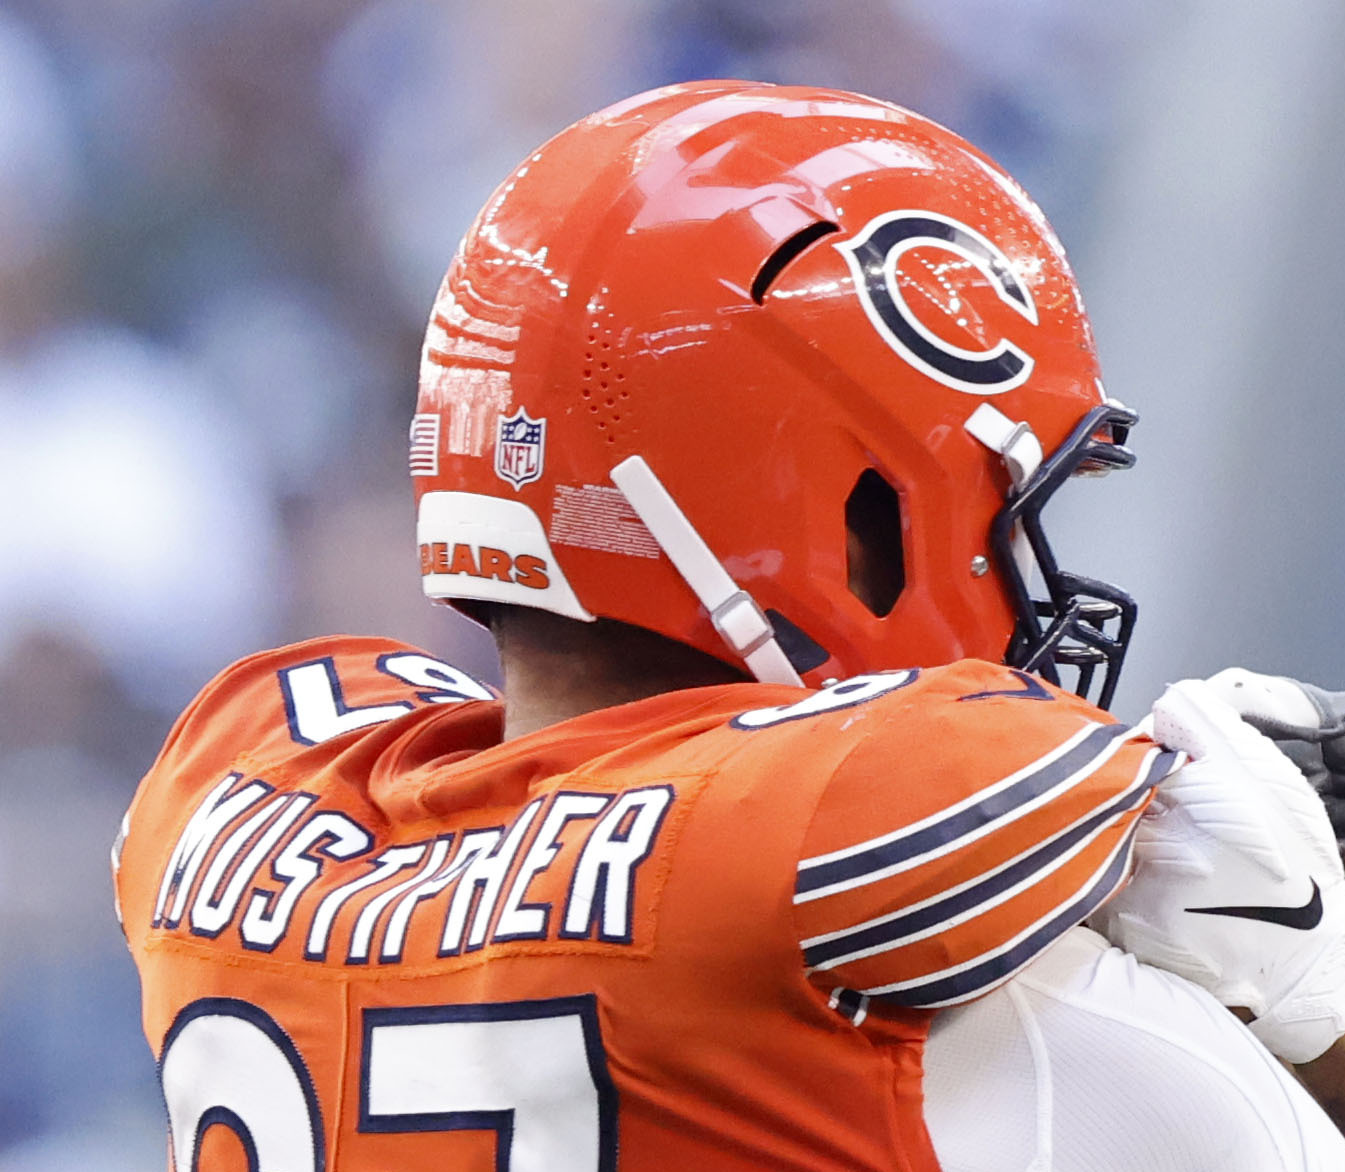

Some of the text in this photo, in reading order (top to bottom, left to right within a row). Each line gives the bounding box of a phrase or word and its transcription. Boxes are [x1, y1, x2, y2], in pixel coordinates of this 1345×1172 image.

[832, 209, 1040, 396] C
[501, 443, 537, 474] NFL
[419, 542, 550, 590] BEARS
[151, 769, 675, 966] MUSTIPHER
